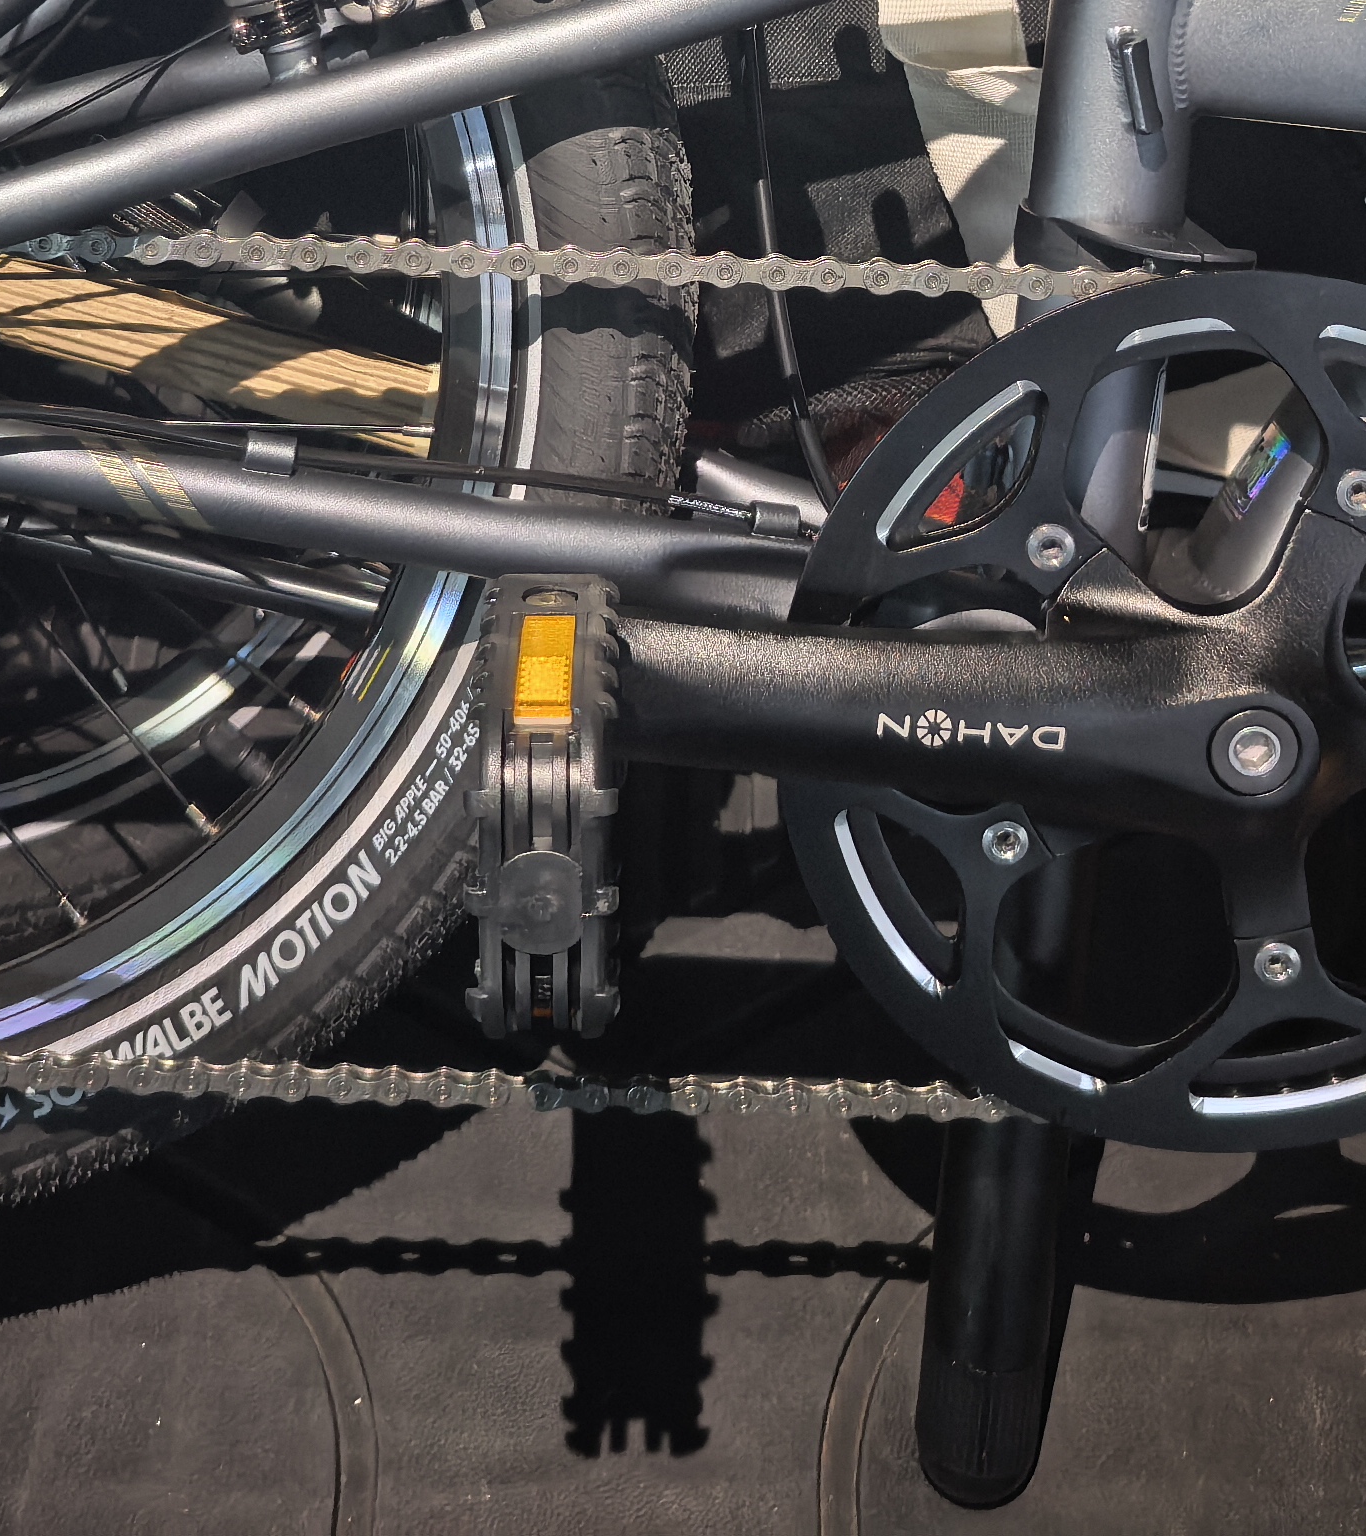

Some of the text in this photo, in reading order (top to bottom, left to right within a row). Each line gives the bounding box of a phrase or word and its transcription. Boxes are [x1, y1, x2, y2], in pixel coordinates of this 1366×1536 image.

[372, 818, 396, 852] BIG
[395, 774, 428, 826] APPLE
[436, 700, 470, 758] 50-406
[385, 809, 428, 867] 2.2-4.5
[421, 780, 450, 817] BAR
[448, 723, 480, 773] 32-65
[878, 709, 1066, 751] DAHON
[237, 849, 383, 1010] MOTION
